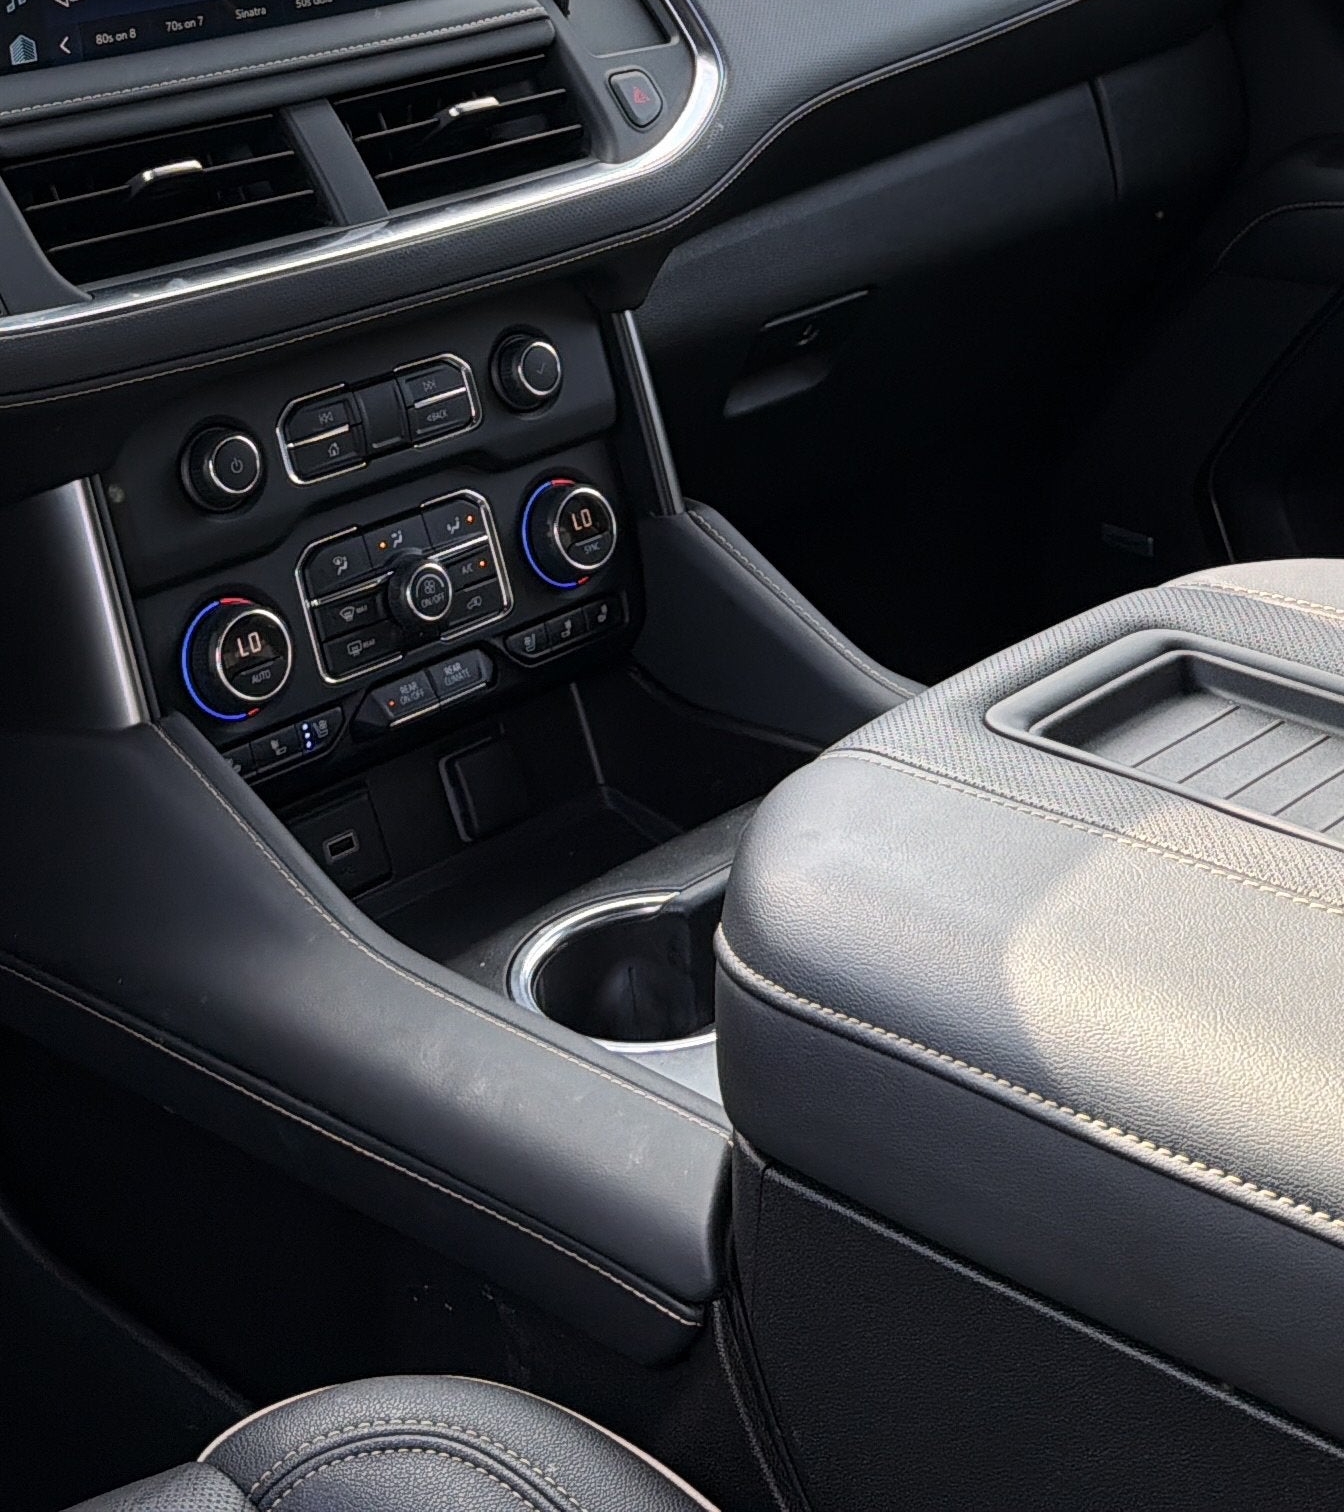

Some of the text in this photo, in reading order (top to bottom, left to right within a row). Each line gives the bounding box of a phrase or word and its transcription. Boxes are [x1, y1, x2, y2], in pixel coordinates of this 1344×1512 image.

[235, 6, 267, 20] Sinatra
[165, 15, 204, 32] 70s on 7
[95, 28, 137, 45] 80s on 8
[571, 508, 593, 530] LO
[237, 631, 262, 657] LO
[251, 669, 271, 685] AUTO
